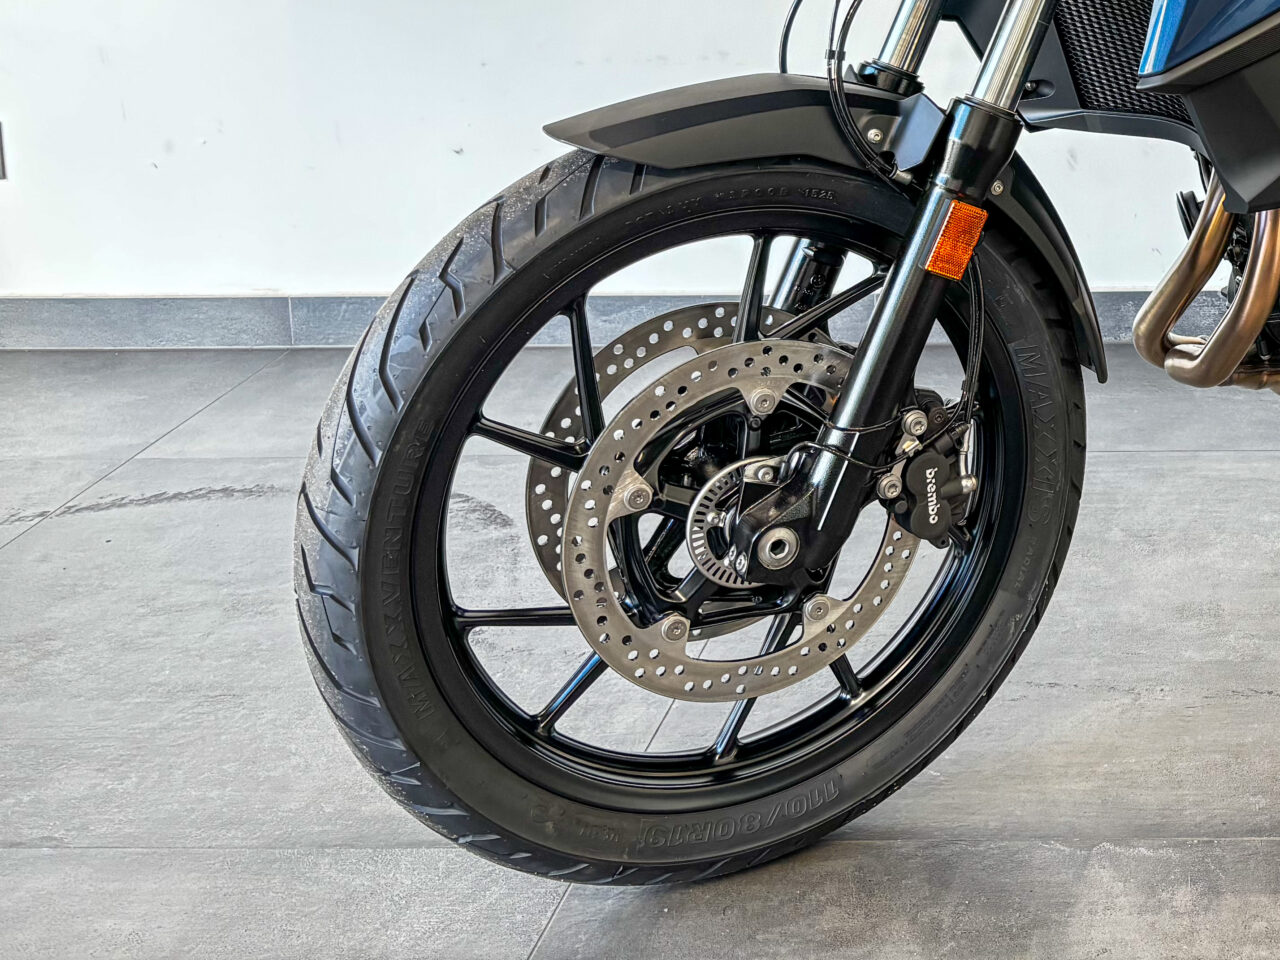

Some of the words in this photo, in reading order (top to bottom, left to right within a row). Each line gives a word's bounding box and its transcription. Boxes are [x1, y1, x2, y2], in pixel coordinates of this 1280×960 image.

[803, 189, 835, 200] 1525
[1015, 344, 1058, 525] MAXXIS
[925, 467, 941, 524] brembo
